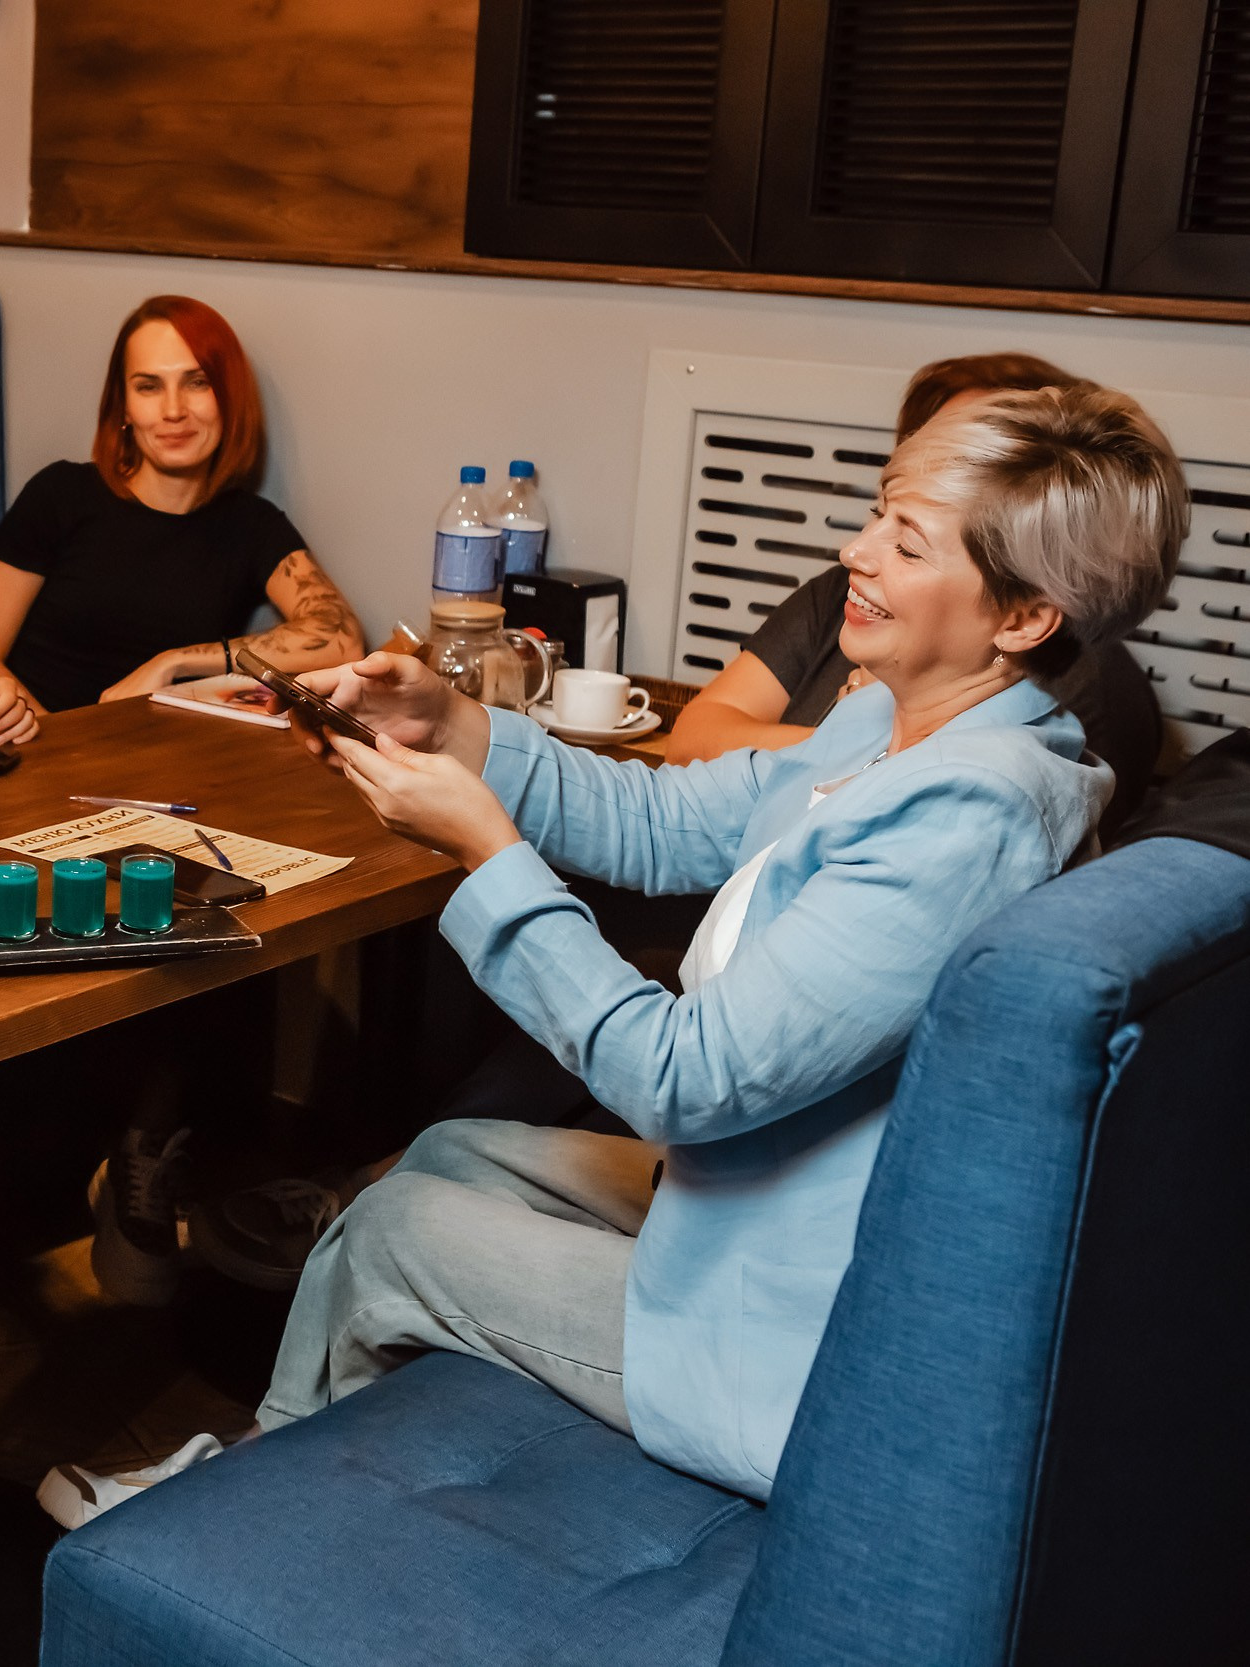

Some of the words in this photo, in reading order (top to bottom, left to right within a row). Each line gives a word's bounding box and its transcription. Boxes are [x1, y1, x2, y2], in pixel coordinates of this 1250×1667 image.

[10, 828, 73, 848] МЕНЮ
[70, 809, 133, 831] КУХНИ
[253, 856, 319, 880] REPUBLIC
